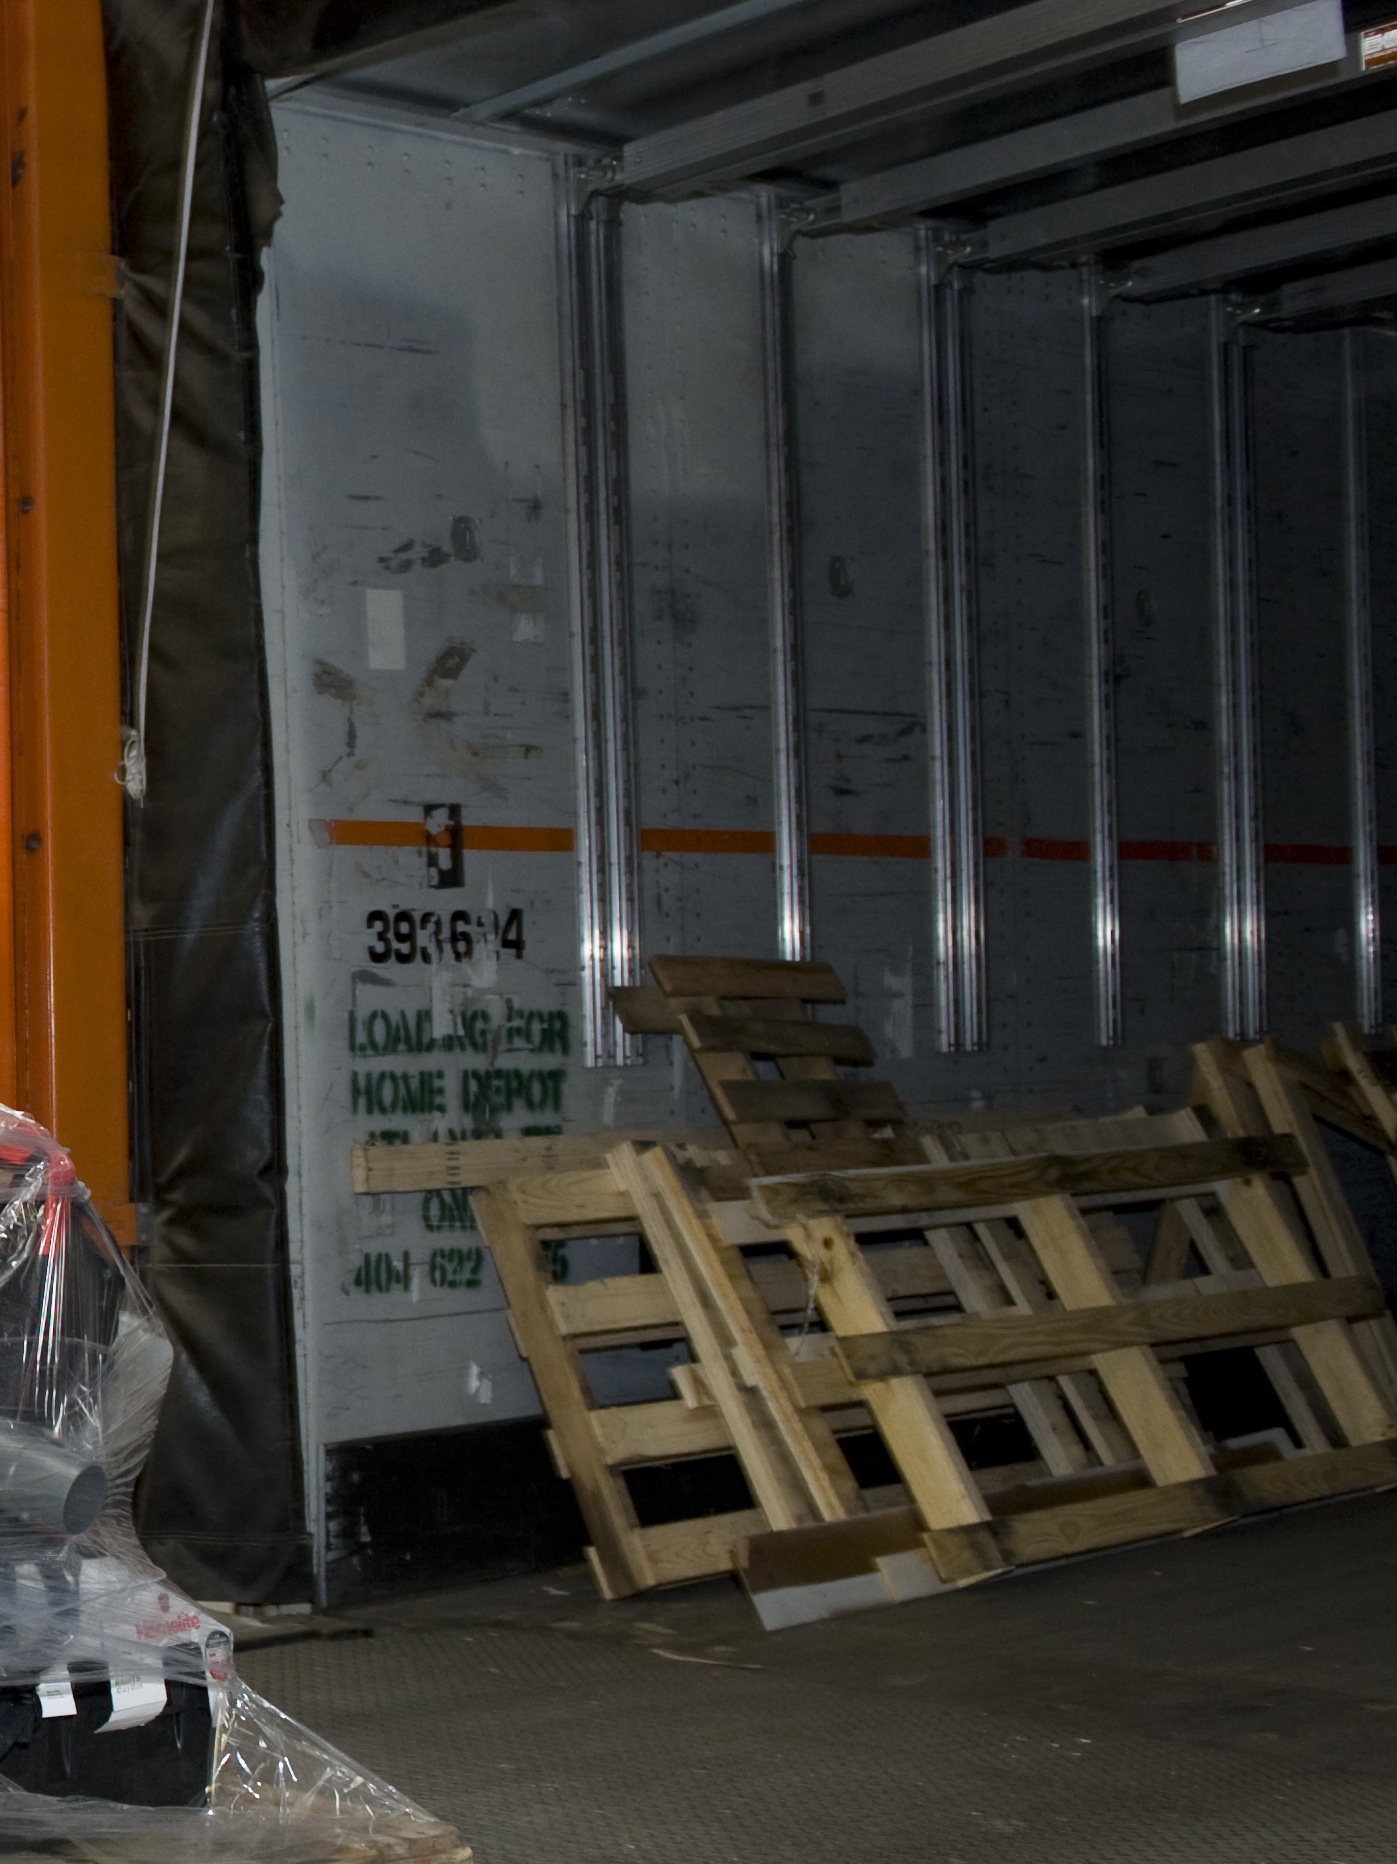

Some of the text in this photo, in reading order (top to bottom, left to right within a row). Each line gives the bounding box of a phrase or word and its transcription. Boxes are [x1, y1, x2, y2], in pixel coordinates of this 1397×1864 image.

[348, 1008, 492, 1053] LOADNG
[351, 1067, 567, 1115] HOME DEPOT
[422, 1187, 478, 1233] ON
[354, 1250, 411, 1294] 404
[429, 1247, 484, 1289] 622
